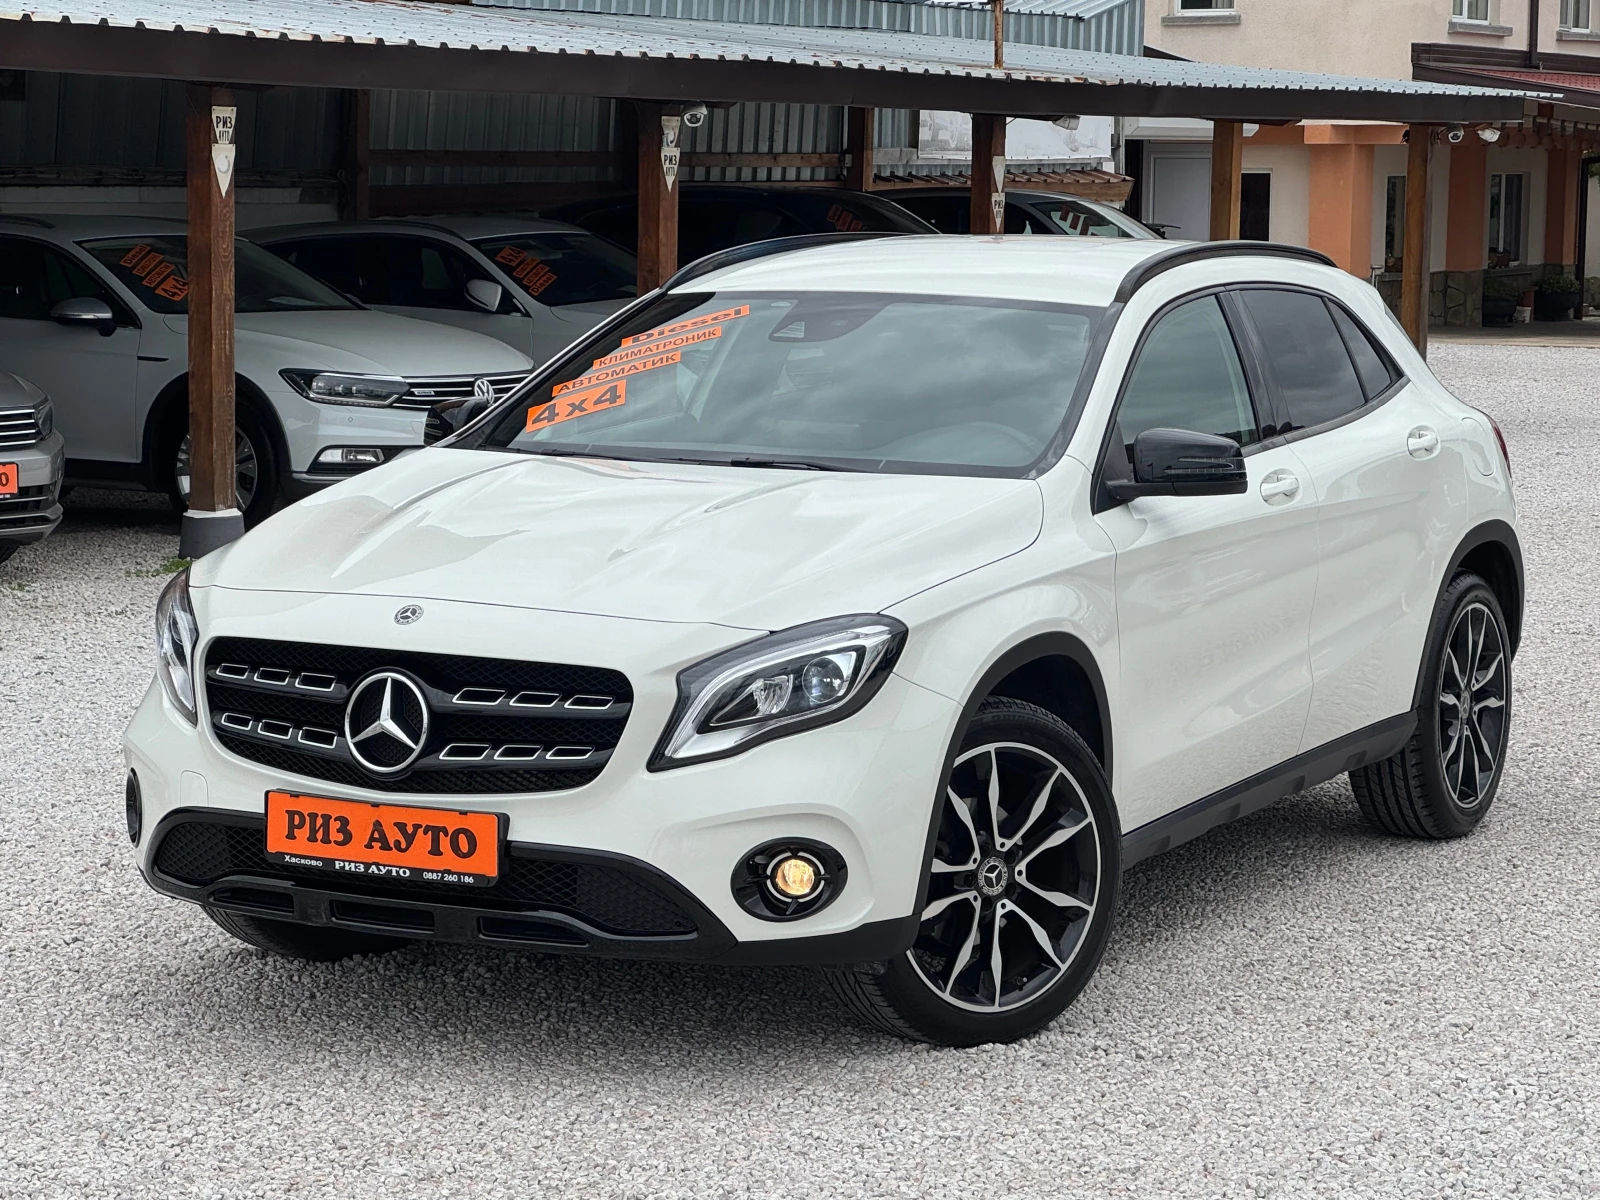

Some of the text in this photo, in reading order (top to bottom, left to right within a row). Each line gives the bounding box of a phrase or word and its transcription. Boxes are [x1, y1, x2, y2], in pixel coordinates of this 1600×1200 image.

[216, 115, 233, 129] РИЗ
[664, 154, 677, 166] РИЗ
[122, 245, 148, 265] Diesel
[531, 274, 555, 293] Diesel
[631, 308, 742, 344] Diesel
[598, 328, 717, 367] КЛИМАТРОНИК
[557, 353, 677, 394] АВТОМАТИК
[531, 384, 622, 425] 4x4
[285, 809, 478, 859] РИЗ АУТО
[284, 854, 474, 884] Хасково РИЗ АУТО 0887 260 186
